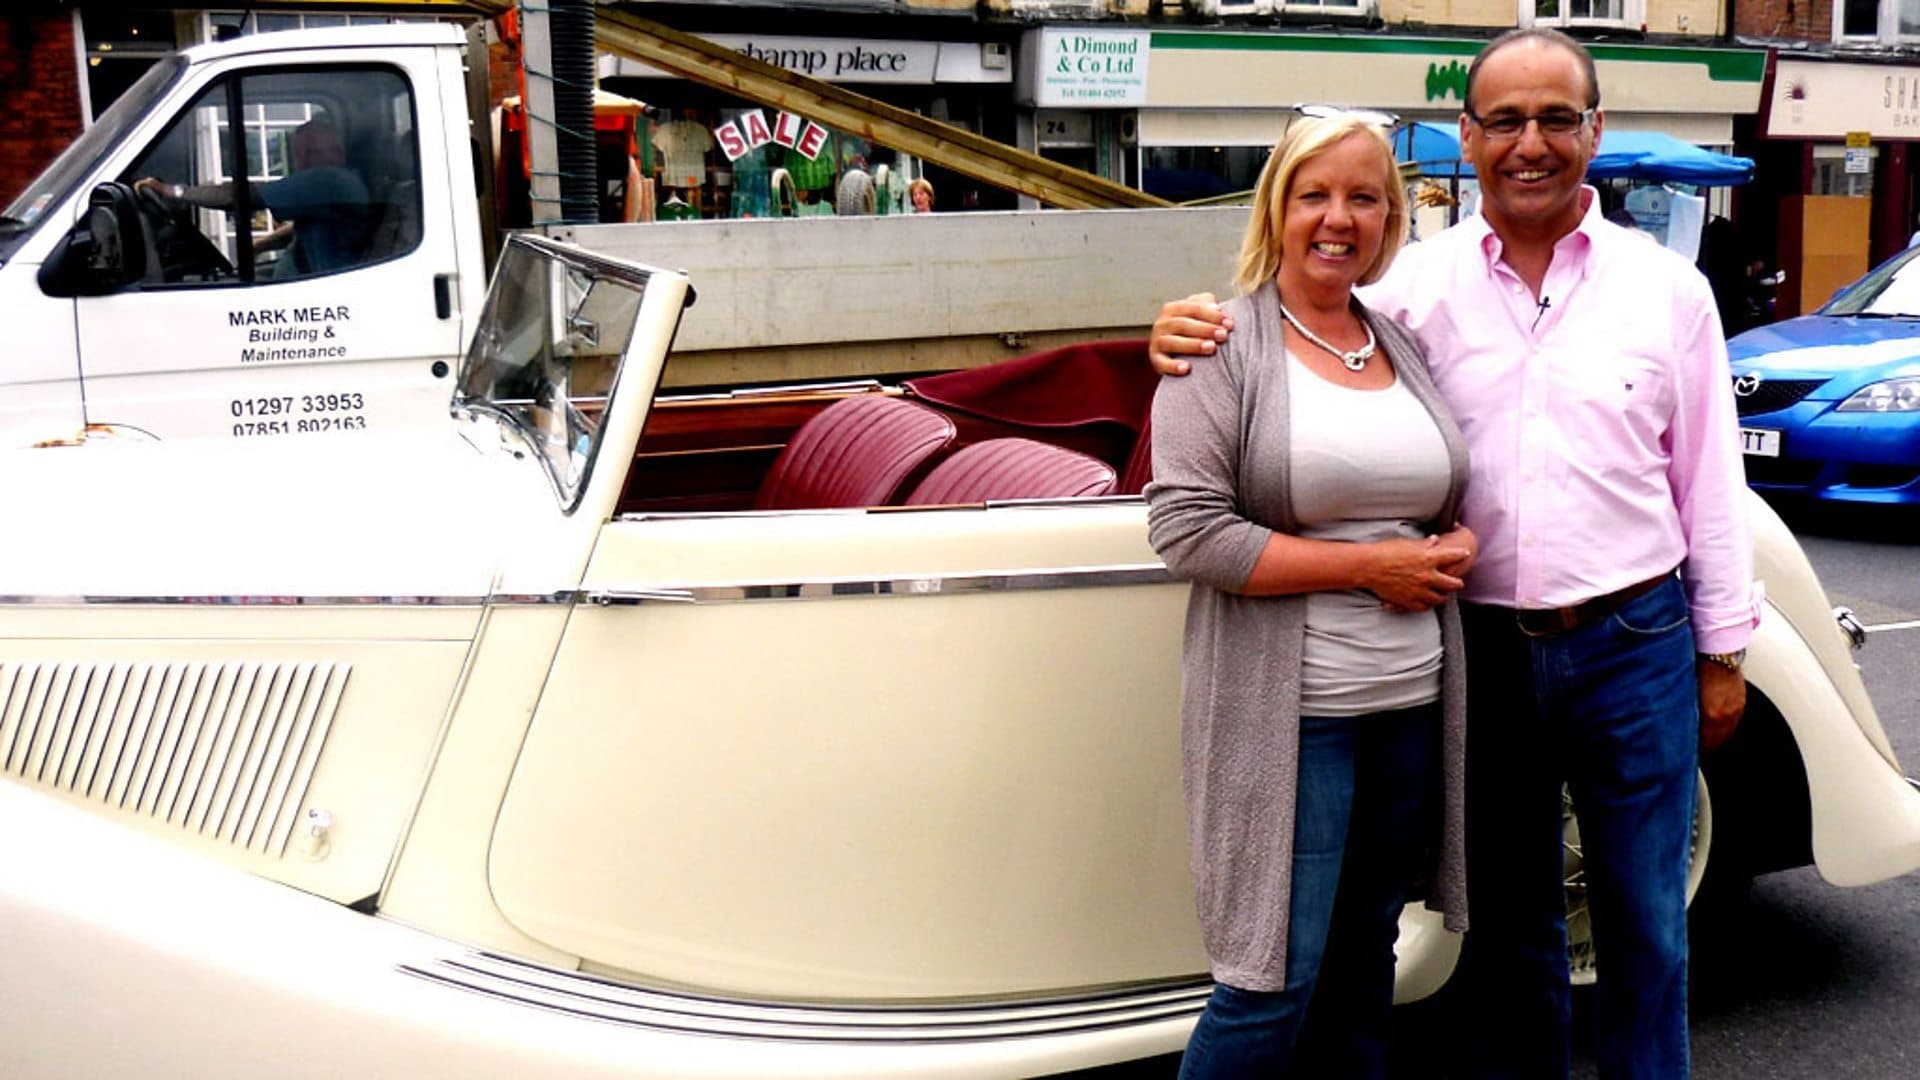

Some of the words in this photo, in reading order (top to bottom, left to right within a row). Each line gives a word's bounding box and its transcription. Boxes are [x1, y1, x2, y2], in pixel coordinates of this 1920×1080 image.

[1056, 38, 1068, 53] A
[1073, 36, 1137, 54] Dimond
[835, 46, 906, 75] place
[1056, 56, 1072, 73] &
[1077, 56, 1101, 73] Co
[1105, 56, 1134, 73] Ltd
[718, 111, 826, 158] SALE
[228, 308, 288, 326] MARK
[293, 306, 350, 323] MEAR
[248, 327, 319, 343] Building
[323, 325, 335, 338] &
[241, 346, 347, 362] Maintenance
[231, 397, 294, 417] 01297
[301, 393, 364, 413] 33953
[233, 420, 290, 437] 07851
[1740, 430, 1765, 451] TT
